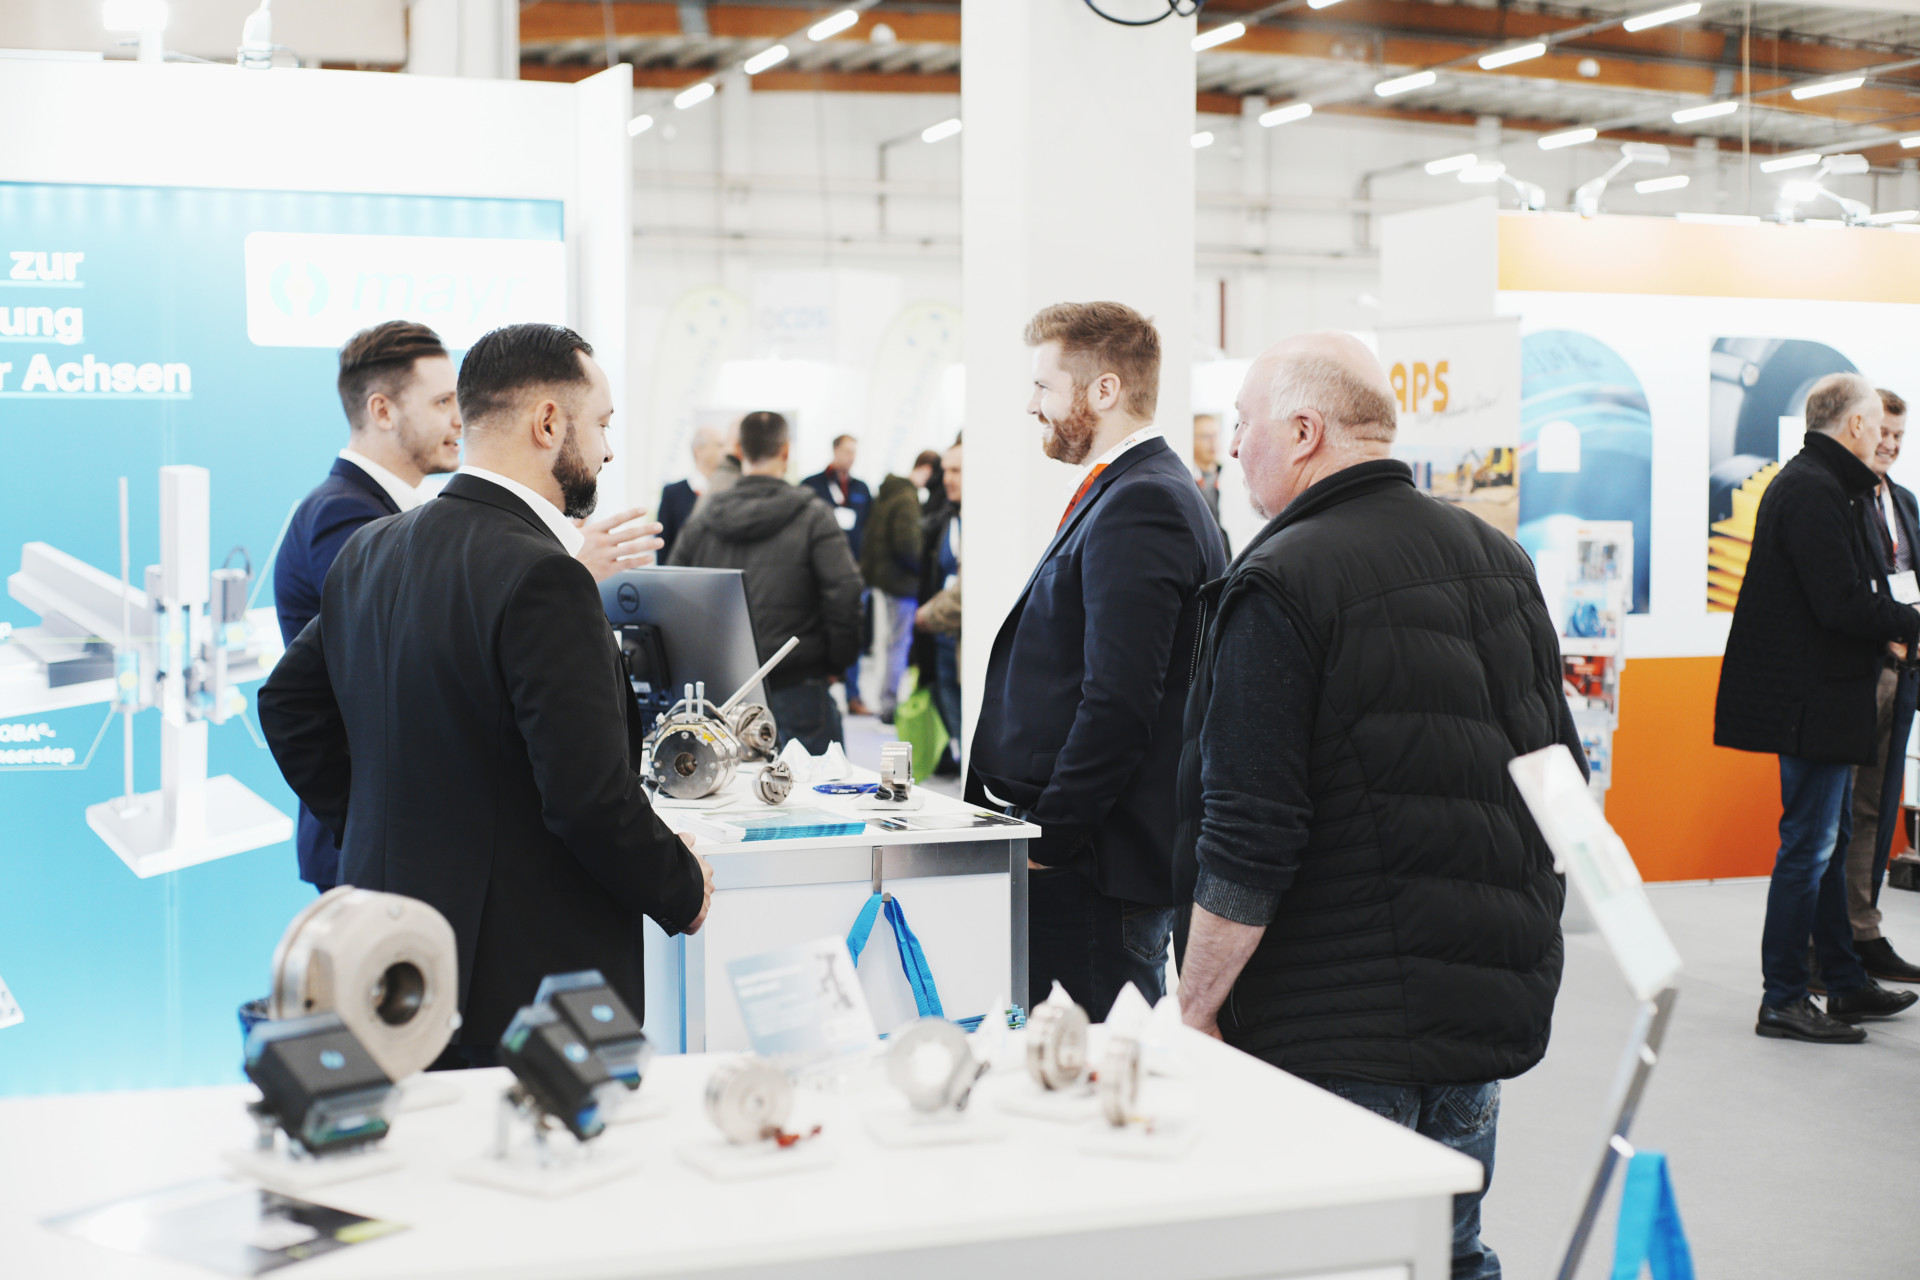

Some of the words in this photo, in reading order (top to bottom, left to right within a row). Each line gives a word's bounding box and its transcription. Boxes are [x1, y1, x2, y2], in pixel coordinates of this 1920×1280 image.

[9, 251, 85, 281] zur
[351, 272, 528, 325] mayr
[21, 353, 192, 393] Achsen
